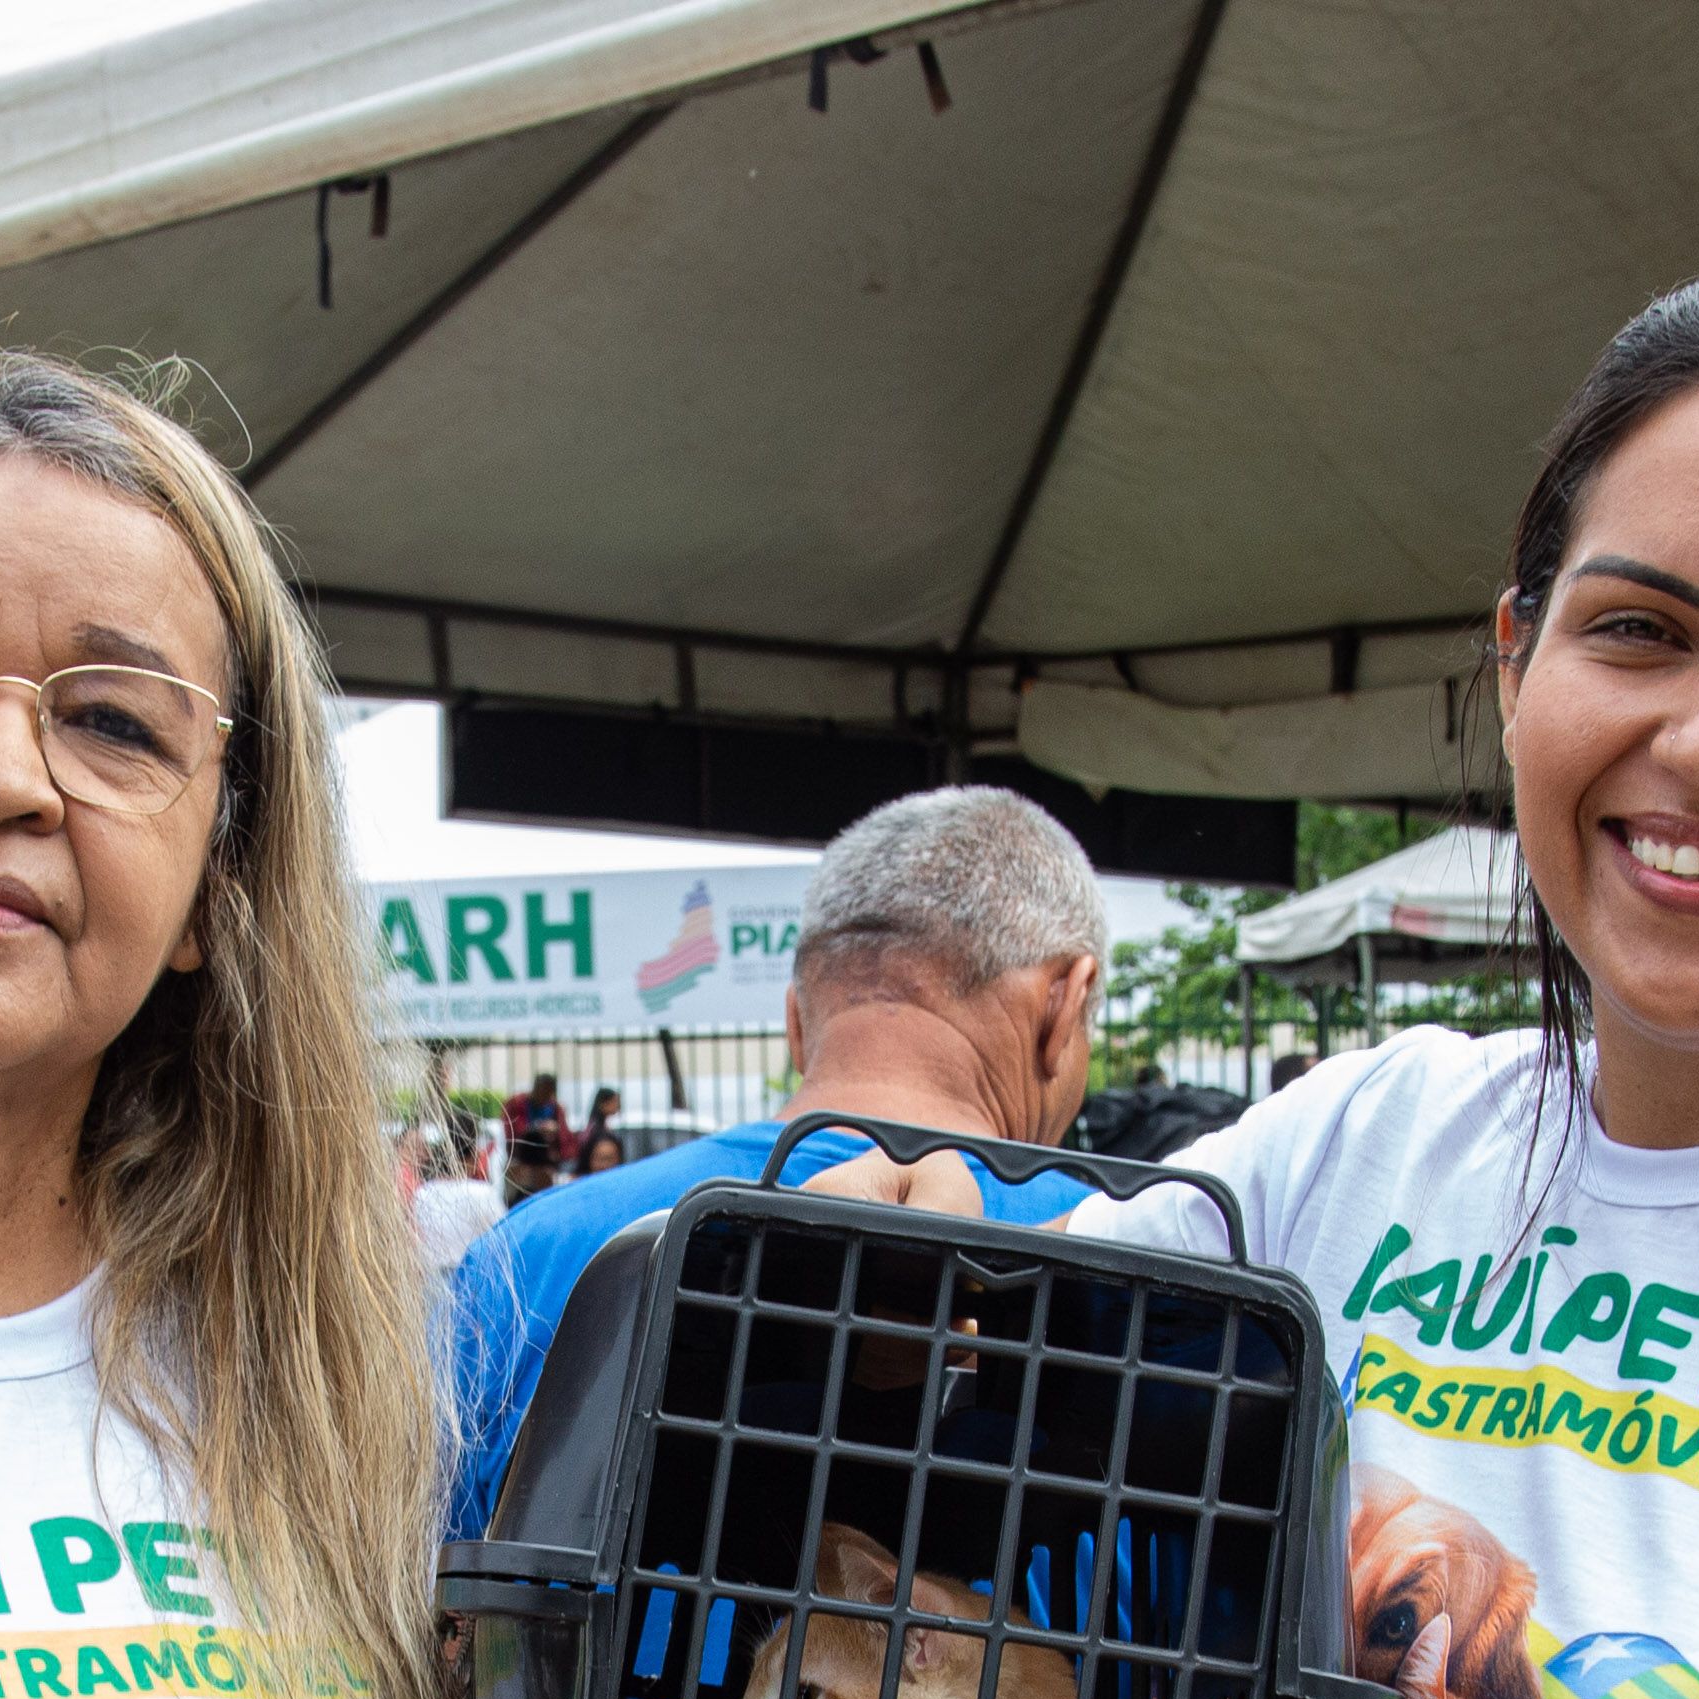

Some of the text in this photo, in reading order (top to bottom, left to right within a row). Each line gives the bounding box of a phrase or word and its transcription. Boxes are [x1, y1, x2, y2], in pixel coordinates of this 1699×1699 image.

[377, 888, 593, 985] ARH
[730, 921, 799, 956] PIA
[1342, 1223, 1578, 1354] IAUÍ
[30, 1516, 236, 1618] PE
